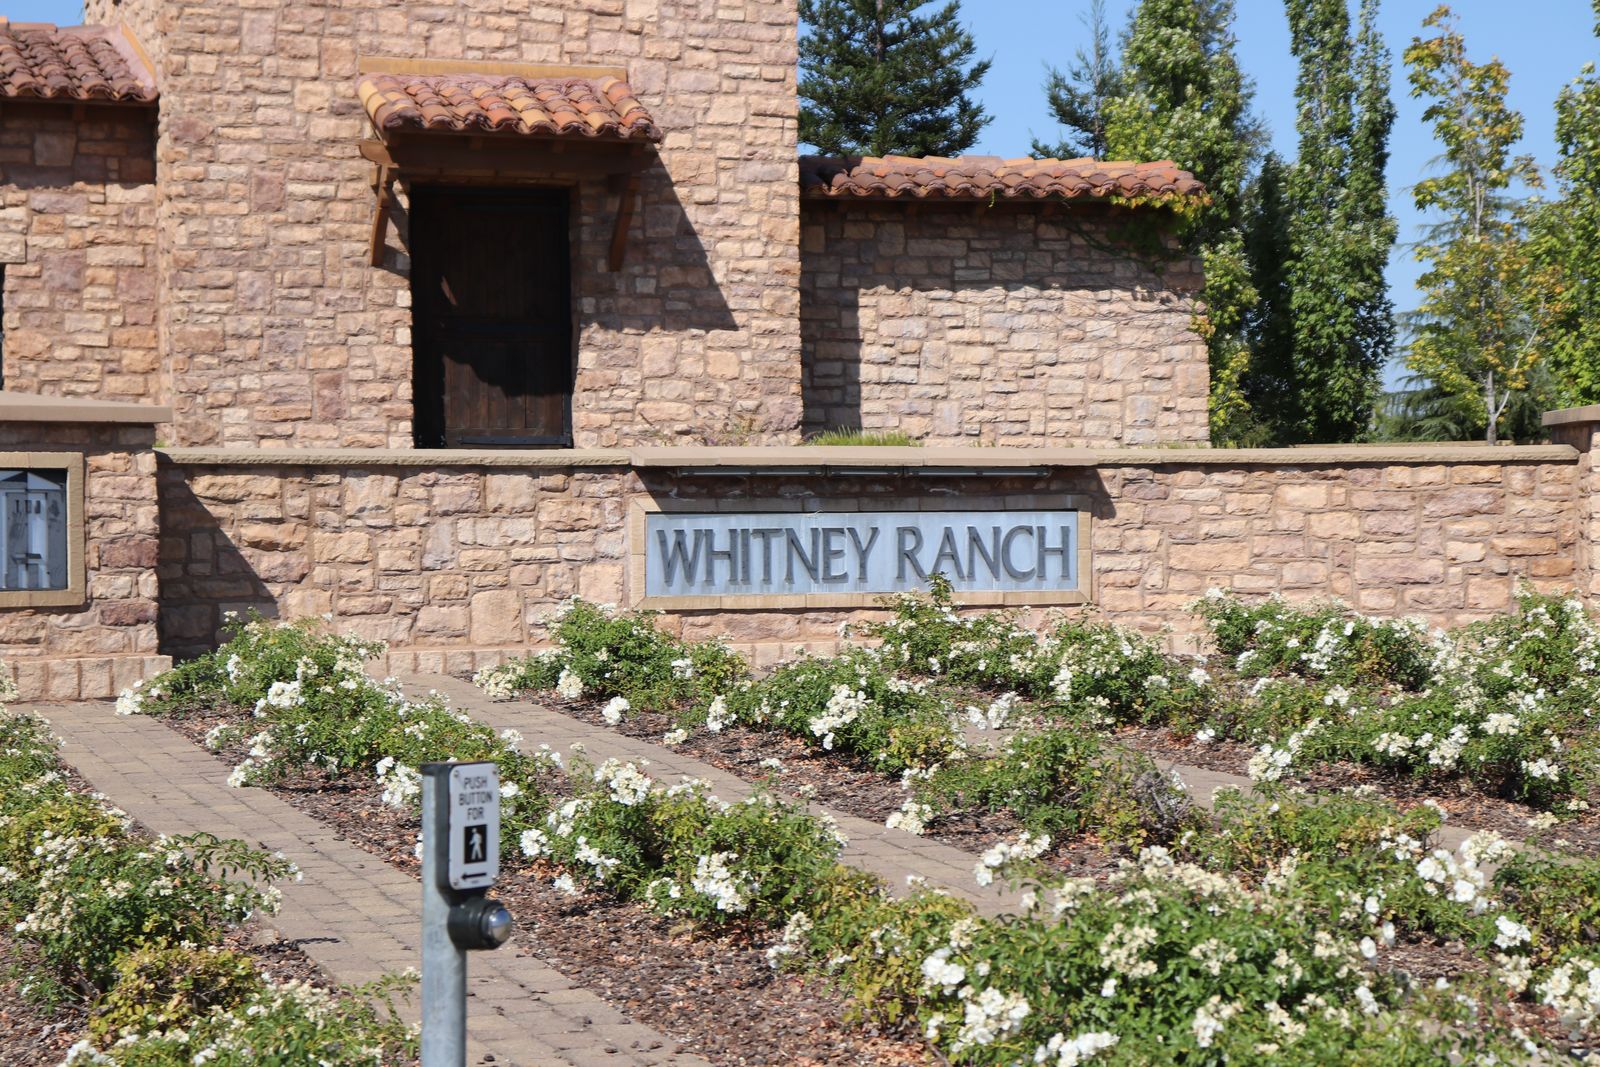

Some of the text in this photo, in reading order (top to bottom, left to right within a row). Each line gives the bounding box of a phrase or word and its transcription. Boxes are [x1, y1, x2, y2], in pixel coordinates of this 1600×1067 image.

[657, 525, 1070, 585] WHITNEY RANCH
[464, 776, 488, 789] PUSH
[459, 791, 492, 806] BUTTON
[467, 807, 484, 820] FOR
